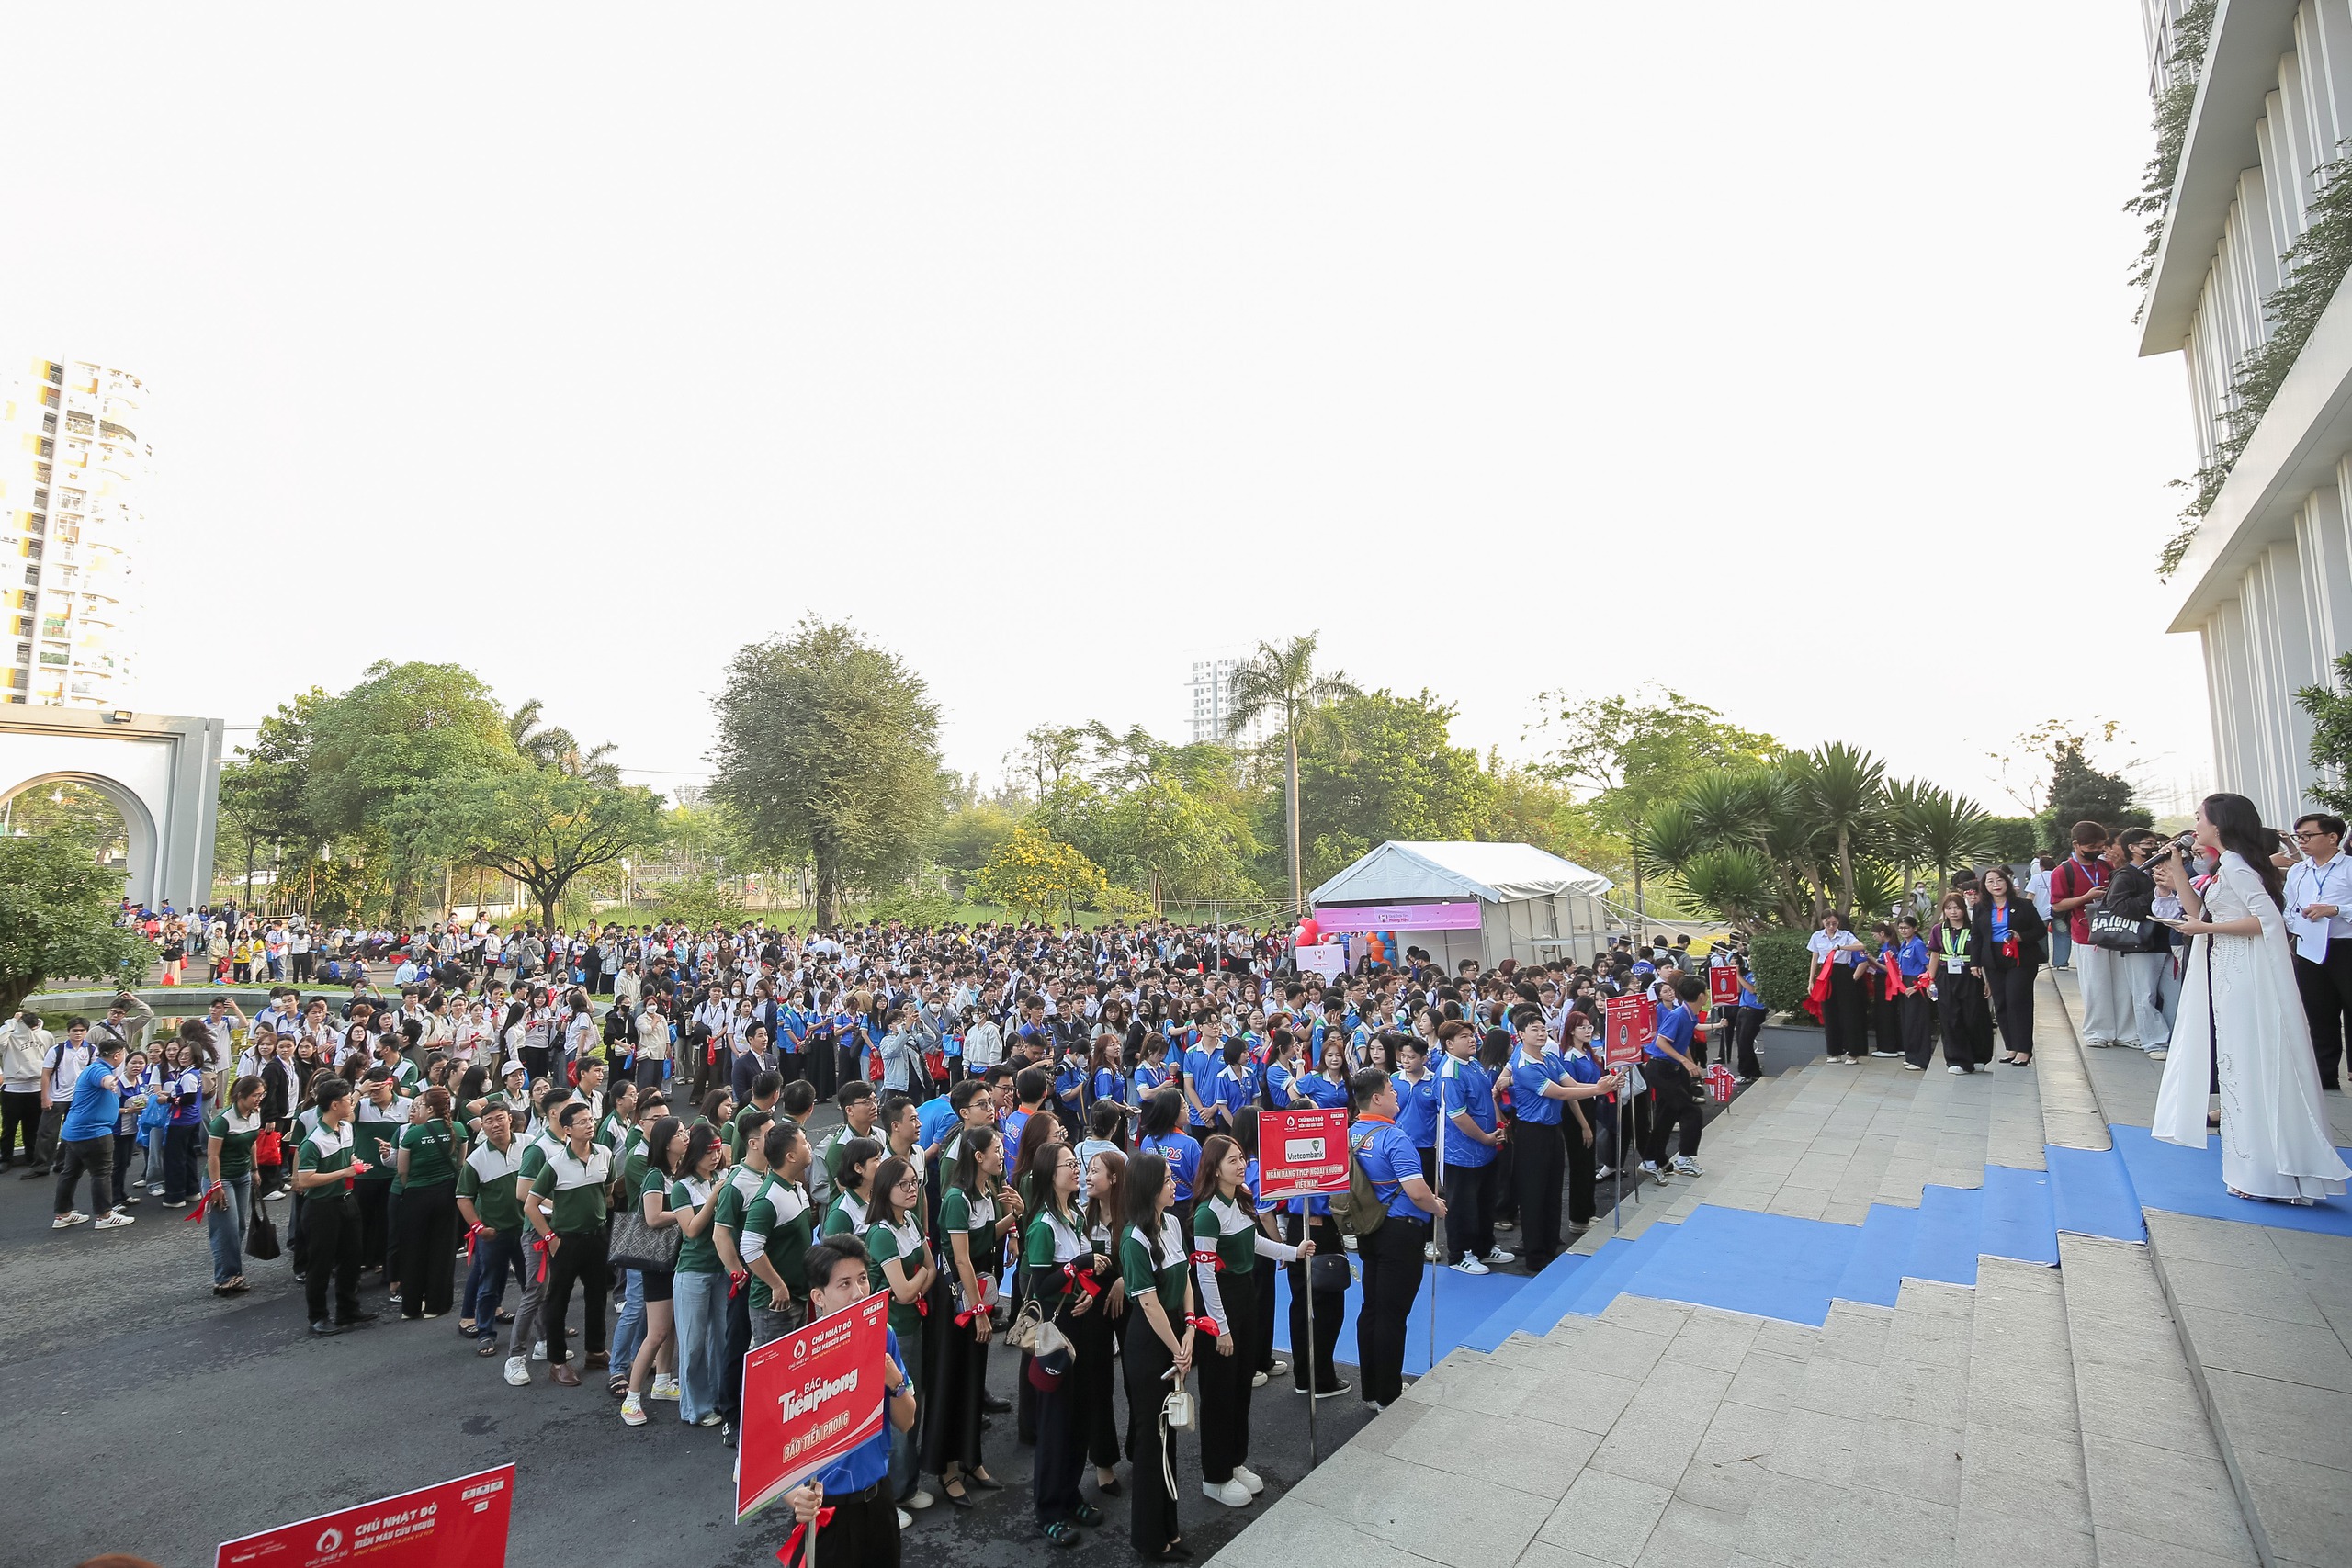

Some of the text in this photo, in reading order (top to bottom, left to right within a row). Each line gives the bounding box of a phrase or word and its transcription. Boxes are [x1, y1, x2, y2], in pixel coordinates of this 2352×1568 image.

[1287, 1151, 1323, 1160] Vietcombank
[811, 1318, 852, 1346] CHỦ NHẬT ĐỎ
[804, 1376, 821, 1394] BÁO
[783, 1437, 801, 1463] BÁO
[822, 1410, 850, 1439] PHONG
[355, 1501, 437, 1536] CHỦ NHẬT ĐỎ
